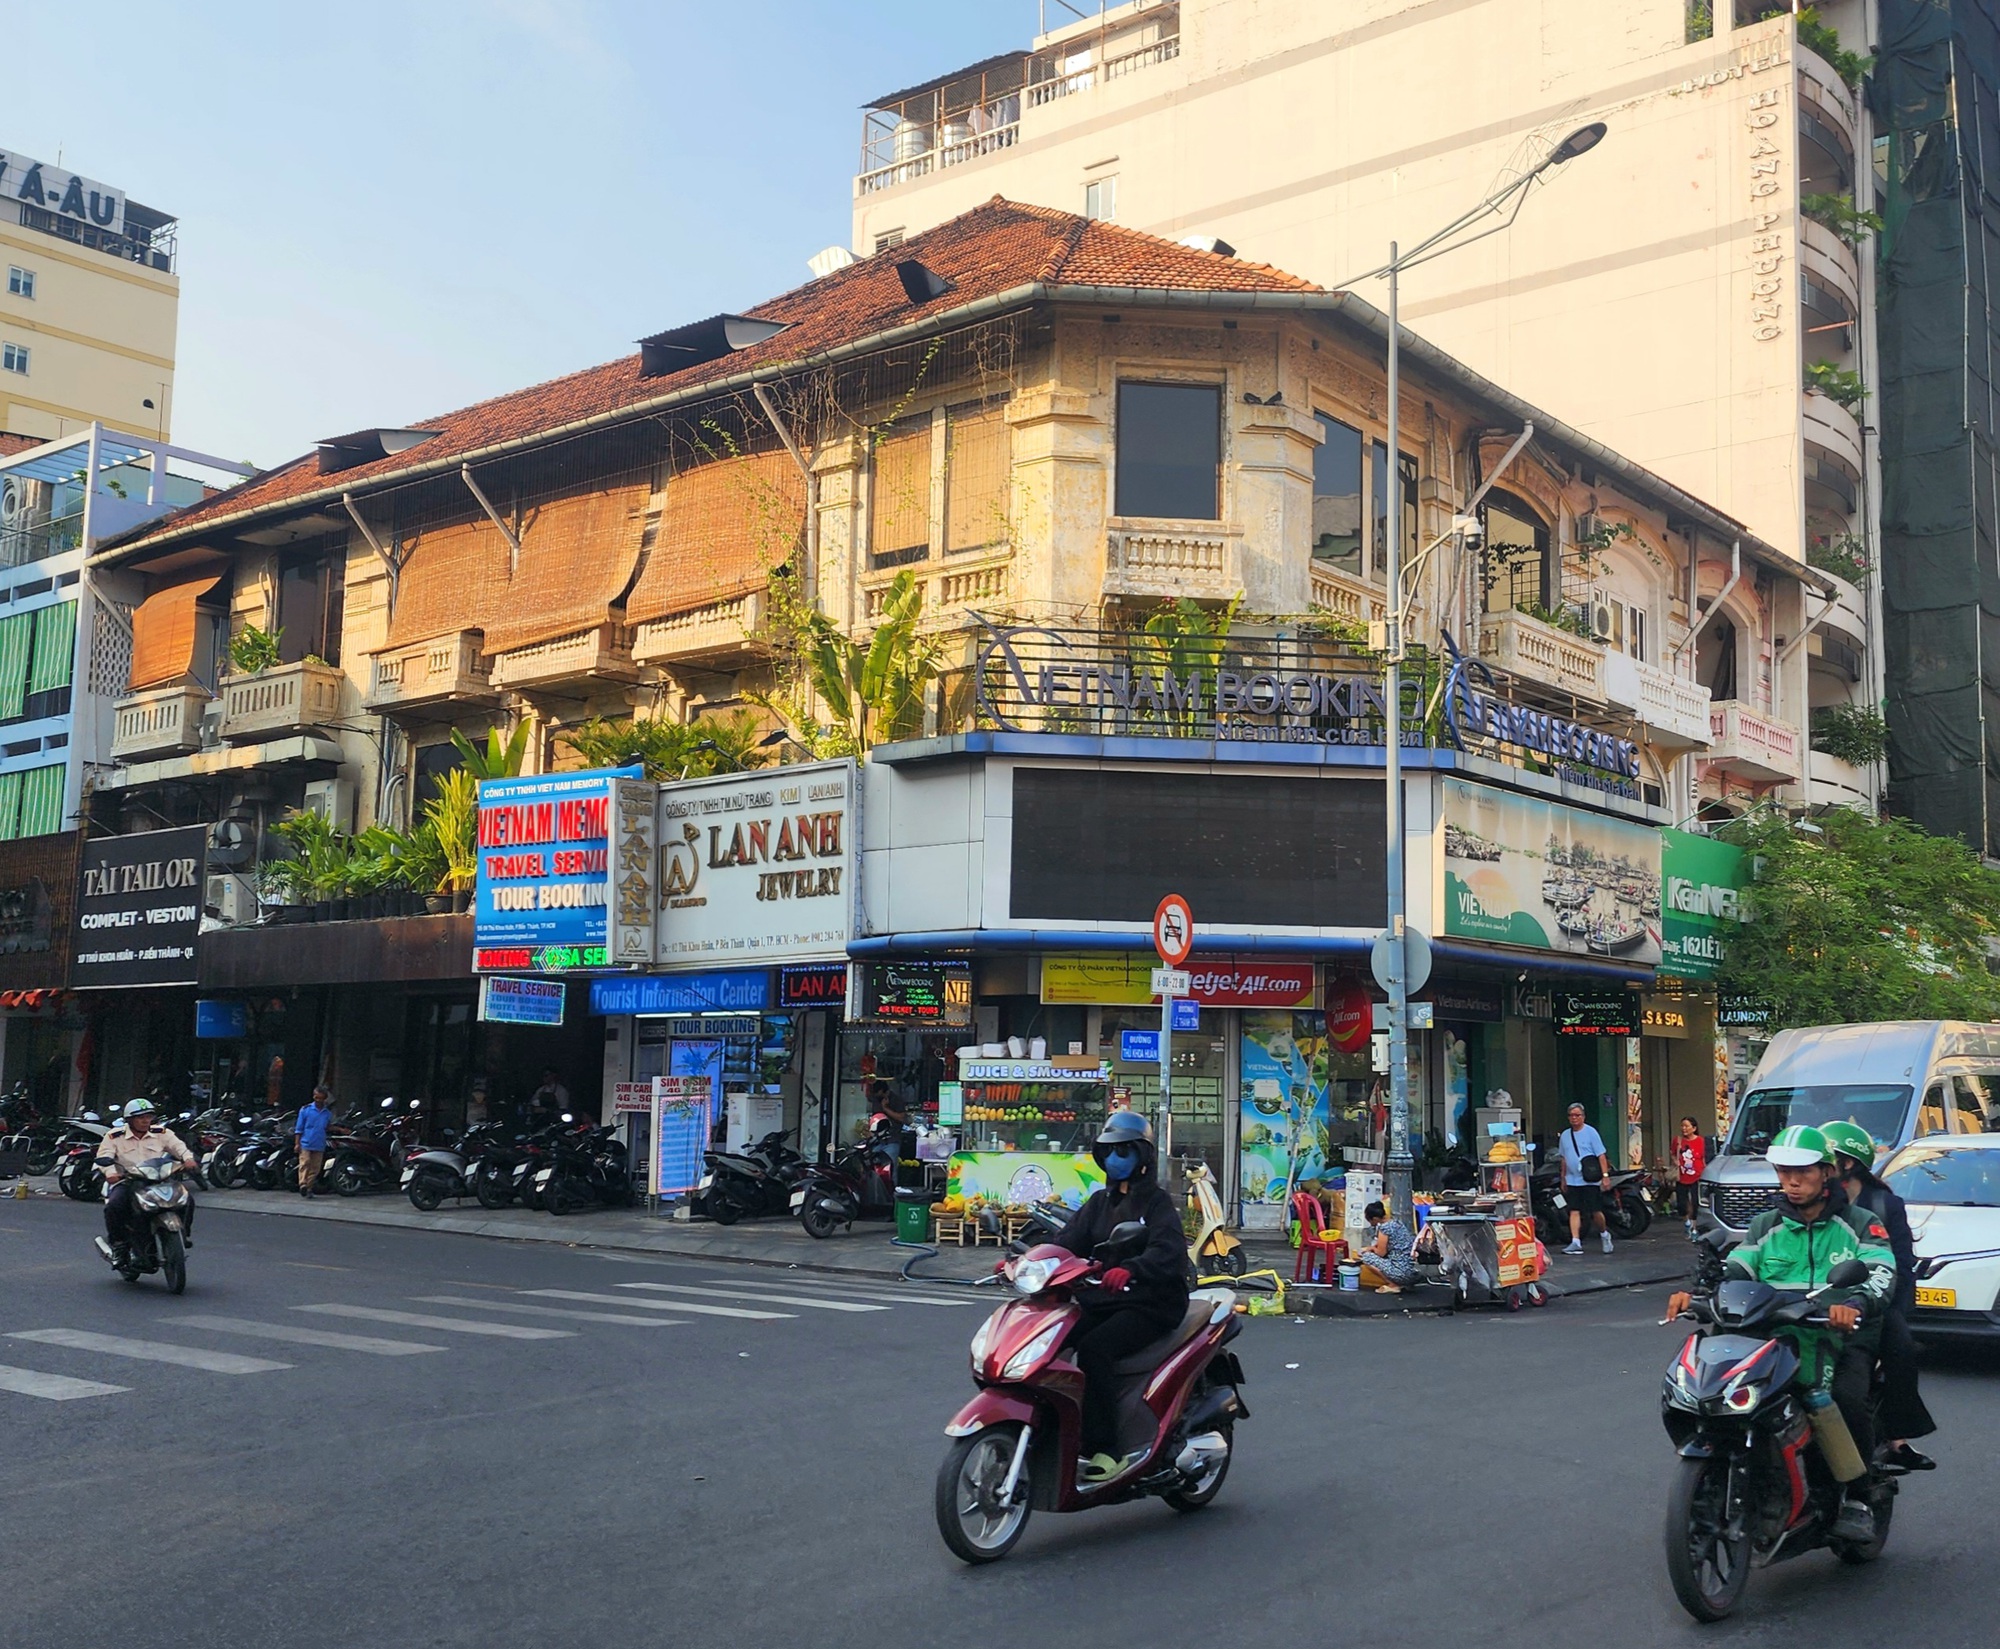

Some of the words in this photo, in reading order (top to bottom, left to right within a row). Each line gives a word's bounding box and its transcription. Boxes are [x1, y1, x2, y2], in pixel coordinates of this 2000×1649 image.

[1682, 53, 1790, 93] HOTEL
[1551, 718, 1640, 779] BOOKING
[484, 787, 505, 798] CÔNG
[571, 778, 604, 789] MEMORY
[666, 800, 688, 818] CÔNG
[700, 797, 721, 814] TNHH
[720, 797, 732, 812] TM
[745, 791, 773, 808] TRANG
[780, 786, 800, 805] KIM
[807, 784, 825, 801] LAN
[825, 781, 844, 798] ANH
[478, 801, 556, 848] VIETNAM
[707, 820, 771, 868] LAN
[773, 811, 843, 861] ANH
[84, 860, 116, 896] TÀI
[121, 859, 198, 893] TAILOR
[486, 853, 548, 880] TRAVEL
[756, 866, 843, 901] JEWELRY
[491, 886, 538, 912] TOUR
[80, 911, 138, 929] COMPLET
[146, 905, 196, 924] VESTON
[1682, 935, 1701, 956] 162
[491, 979, 522, 994] TRAVEL
[525, 983, 562, 997] SERVICE
[593, 983, 637, 1010] Tourist
[641, 981, 716, 1009] Information
[719, 978, 764, 1006] Center
[790, 976, 824, 997] LAN
[945, 980, 970, 1003] NH
[673, 1020, 701, 1034] TOUR
[704, 1020, 755, 1034] BOOKING
[1655, 1010, 1663, 1025] &
[1665, 1012, 1684, 1028] SPA
[661, 1078, 679, 1087] SIM
[968, 1065, 1008, 1078] JUICE
[1012, 1065, 1025, 1078] &
[616, 1084, 631, 1093] SIM
[617, 1094, 630, 1102] 4G
[1845, 1137, 1871, 1156] Grab
